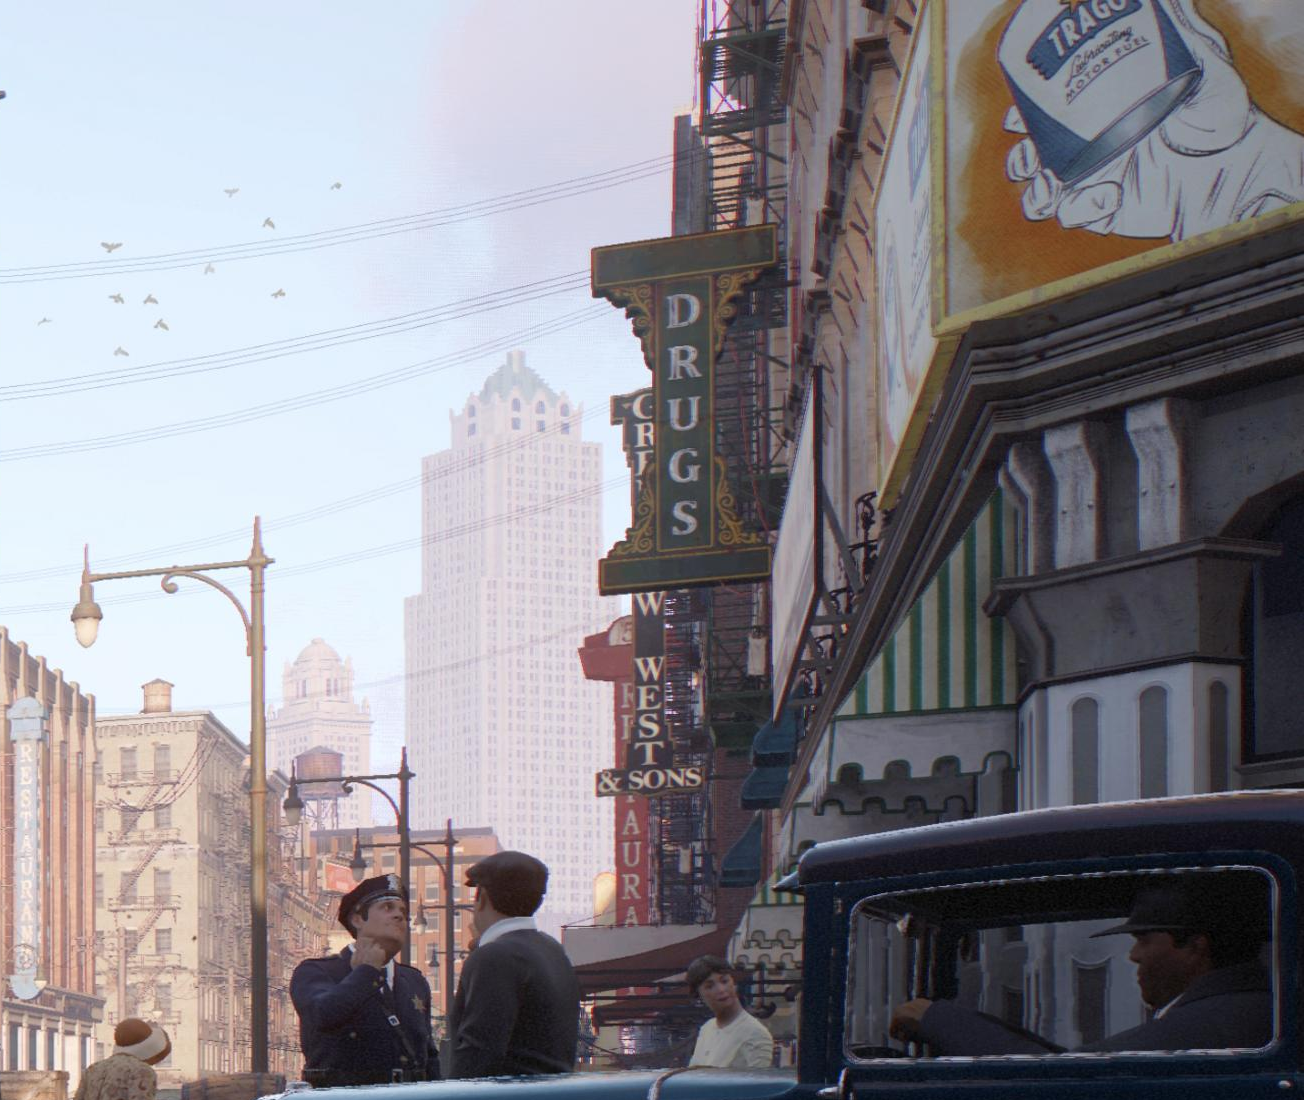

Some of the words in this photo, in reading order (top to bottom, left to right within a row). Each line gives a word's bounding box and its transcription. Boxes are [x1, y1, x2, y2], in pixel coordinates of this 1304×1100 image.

[1065, 27, 1133, 88] Lubricating
[1066, 58, 1110, 102] MOTOR
[1114, 36, 1149, 56] FUEL
[666, 292, 702, 538] DRUGS
[634, 656, 665, 766] WEST
[598, 771, 622, 792] &
[628, 768, 702, 790] SONS
